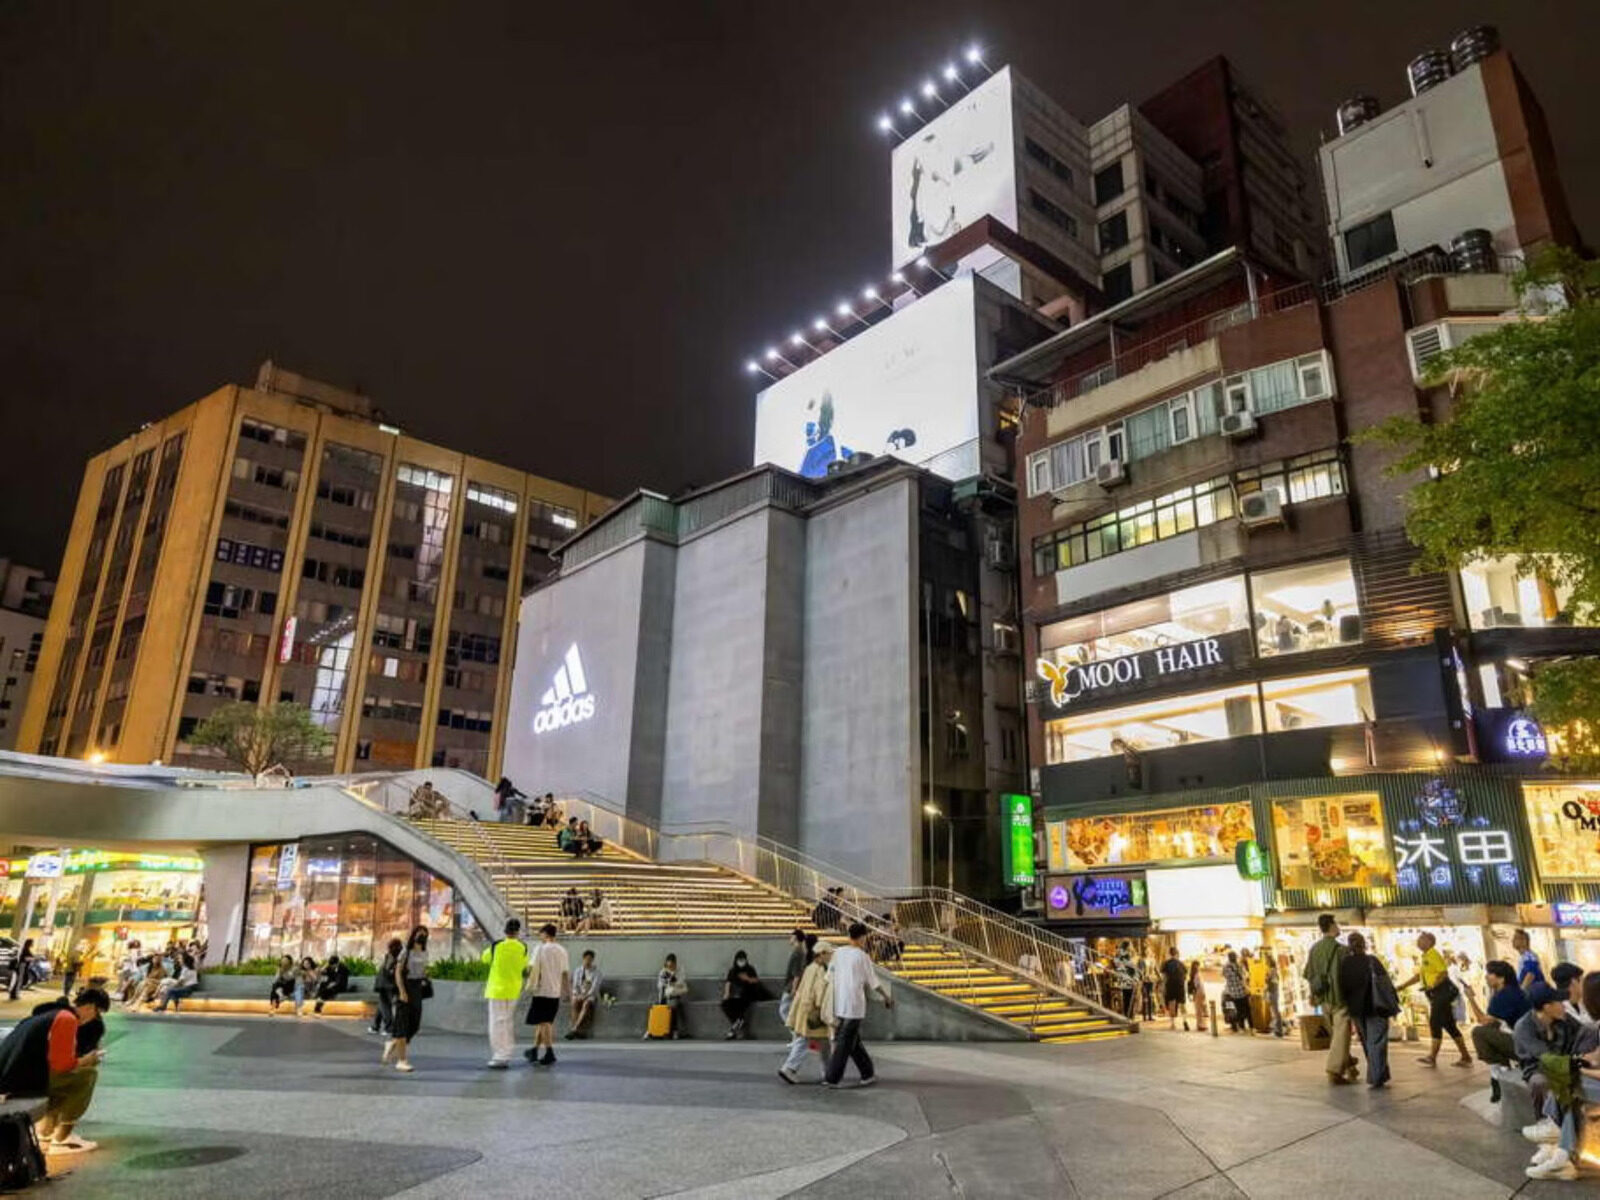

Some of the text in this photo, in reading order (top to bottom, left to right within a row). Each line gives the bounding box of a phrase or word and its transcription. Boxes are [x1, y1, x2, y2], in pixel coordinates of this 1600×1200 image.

[1078, 638, 1223, 691] MOOI HAIR
[534, 694, 595, 734] adidas
[1581, 815, 1600, 831] M
[1393, 830, 1513, 868] 沐田
